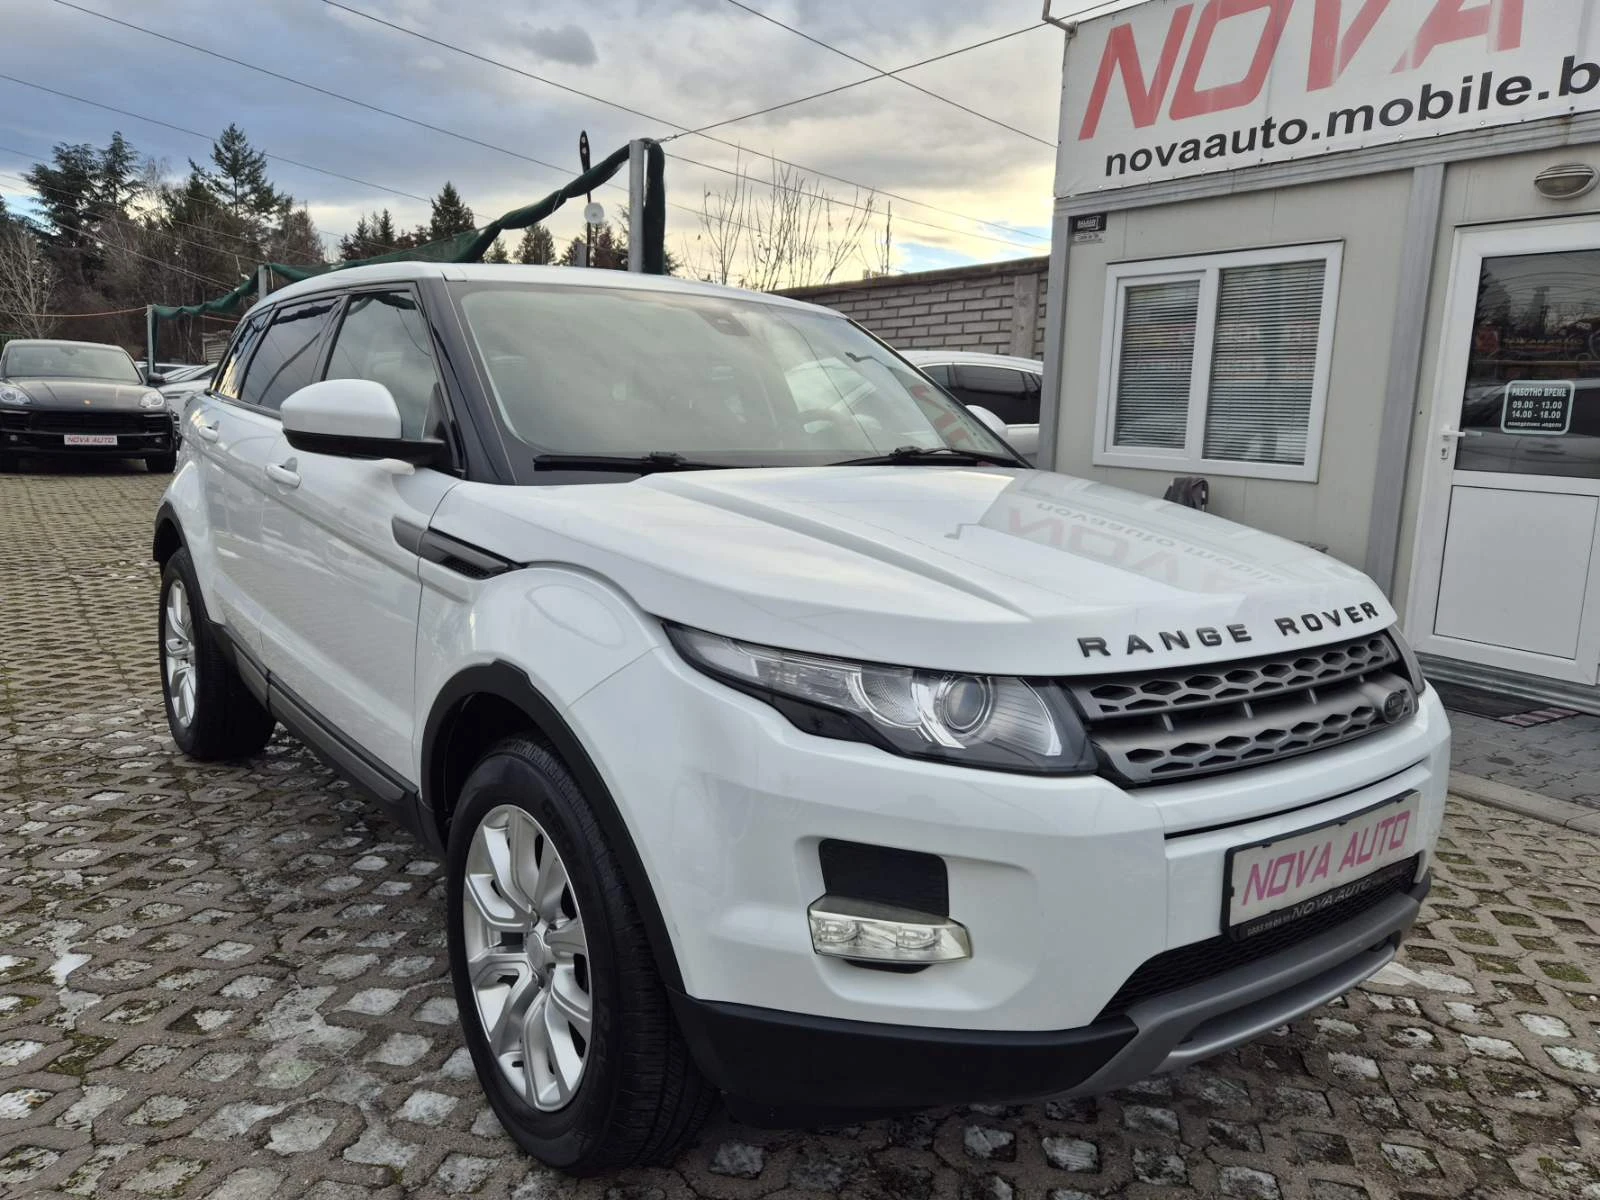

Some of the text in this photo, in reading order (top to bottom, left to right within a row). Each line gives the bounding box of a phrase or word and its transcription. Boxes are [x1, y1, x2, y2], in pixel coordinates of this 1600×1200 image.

[1105, 55, 1600, 177] novaauto.mobile.b
[1511, 410, 1533, 418] 14.00
[1541, 400, 1563, 409] 13.00
[1077, 601, 1379, 658] RANGE ROVER
[1241, 810, 1411, 906] NOVA AUTO
[1292, 879, 1372, 920] NOVA AUTO
